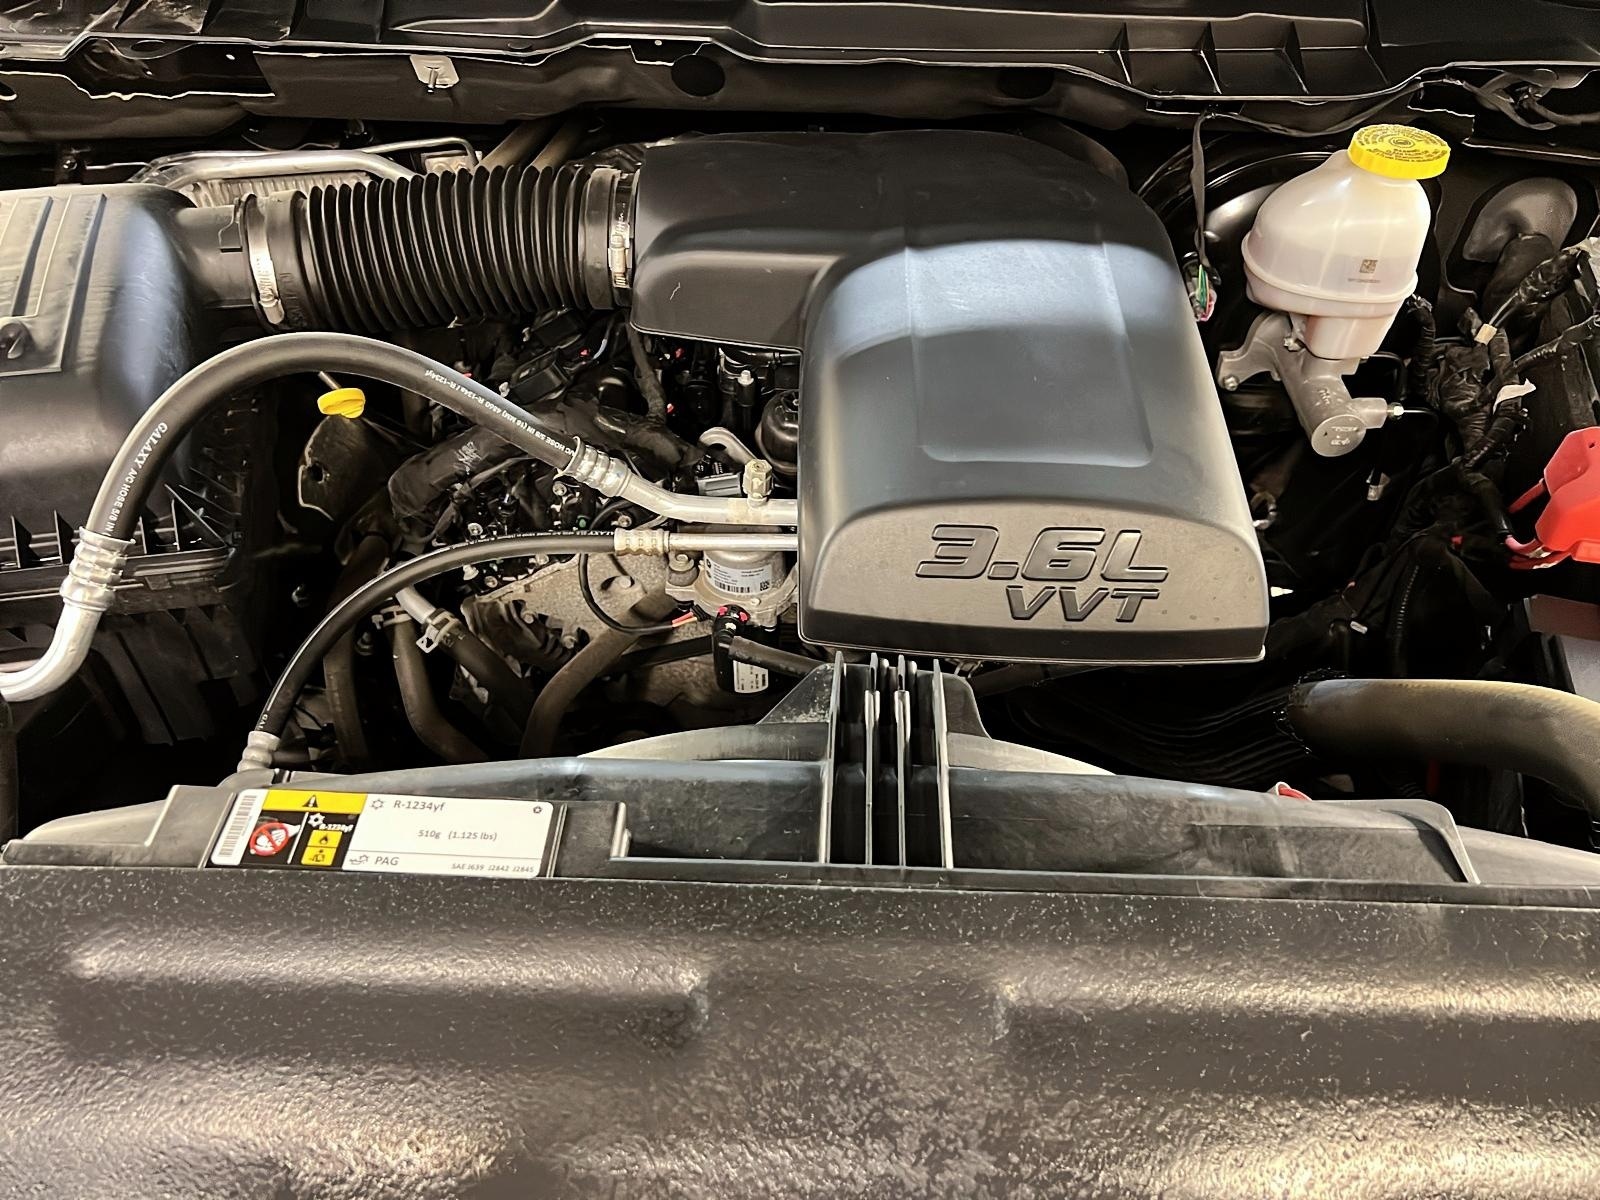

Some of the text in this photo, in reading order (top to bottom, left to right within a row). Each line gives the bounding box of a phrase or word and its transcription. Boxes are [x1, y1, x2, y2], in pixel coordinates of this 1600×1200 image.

[134, 422, 168, 469] GALAXY
[545, 436, 565, 451] HOSE
[113, 482, 131, 509] HOSE
[915, 523, 1169, 583] 3.6L
[1005, 585, 1161, 623] VVT
[393, 799, 446, 812] R-1234yf
[417, 829, 498, 842] 510g (1.125 lbs)
[374, 856, 400, 866] PAG
